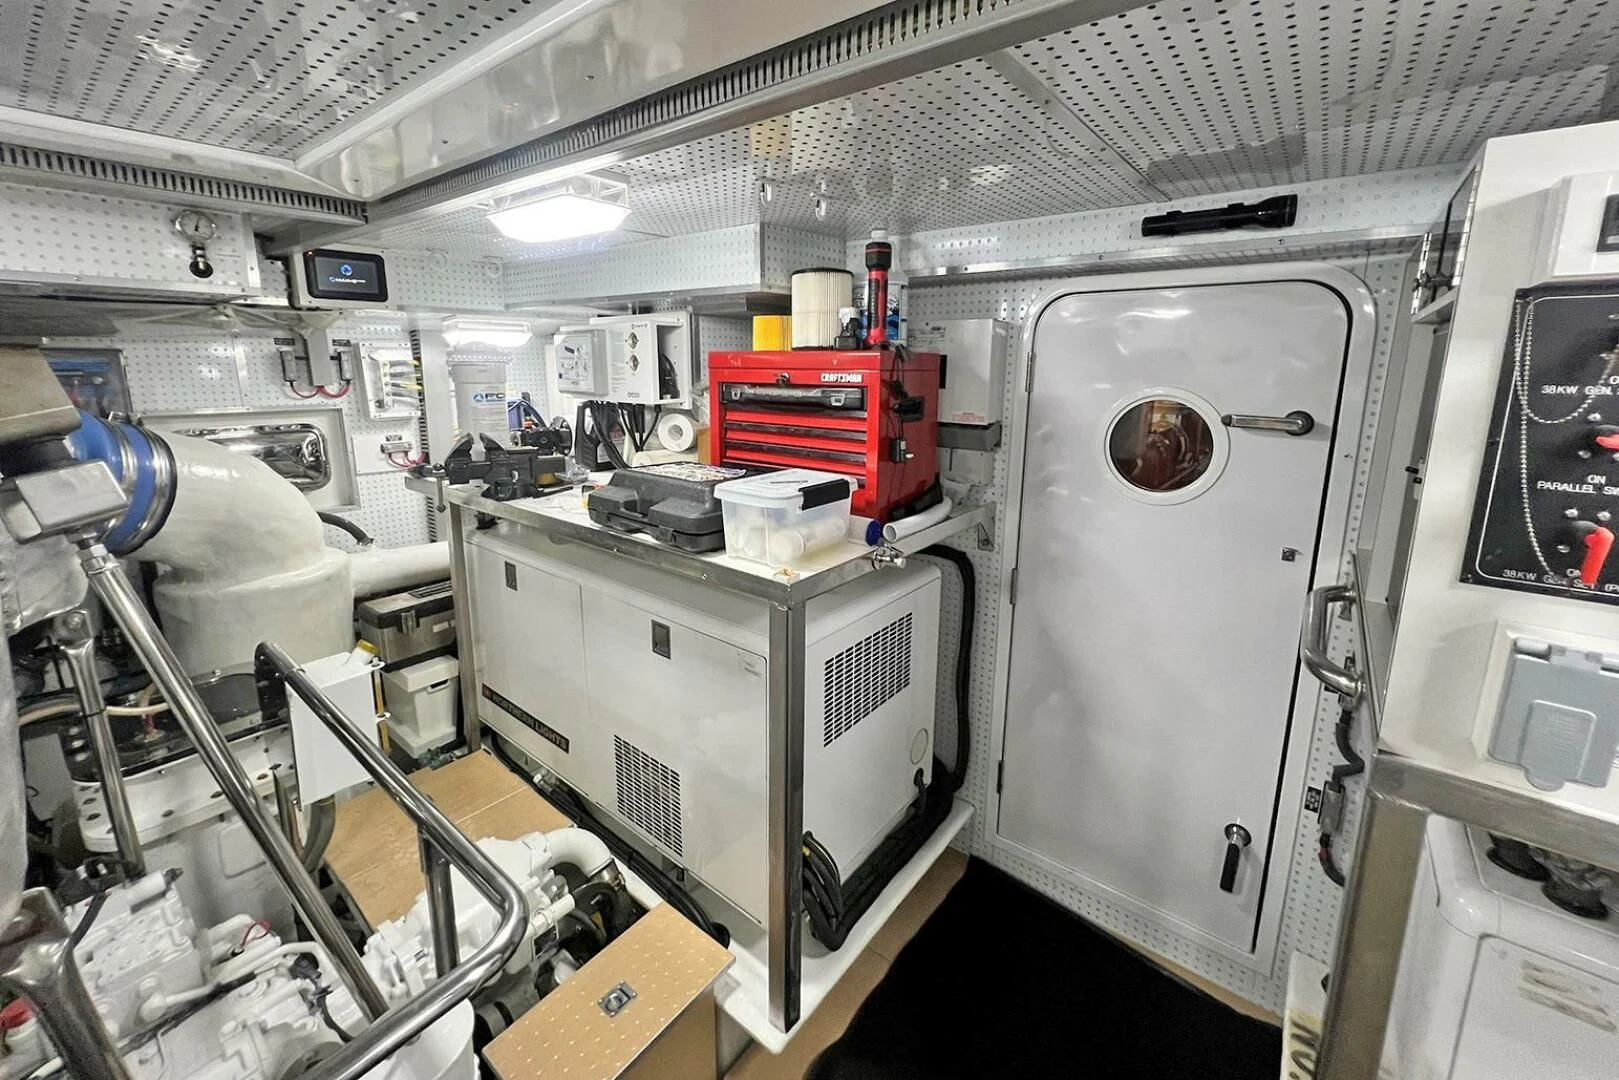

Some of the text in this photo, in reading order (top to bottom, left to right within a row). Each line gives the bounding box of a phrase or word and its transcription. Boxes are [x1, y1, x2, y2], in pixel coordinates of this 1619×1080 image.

[821, 372, 863, 383] CRAFTSMAN
[1541, 384, 1579, 394] 38KW
[1587, 474, 1606, 484] ON
[1537, 480, 1597, 494] PARALLEL
[1502, 569, 1537, 580] 38KW
[1604, 583, 1619, 593] (P
[492, 692, 567, 750] NORTHERN LIGHTS
